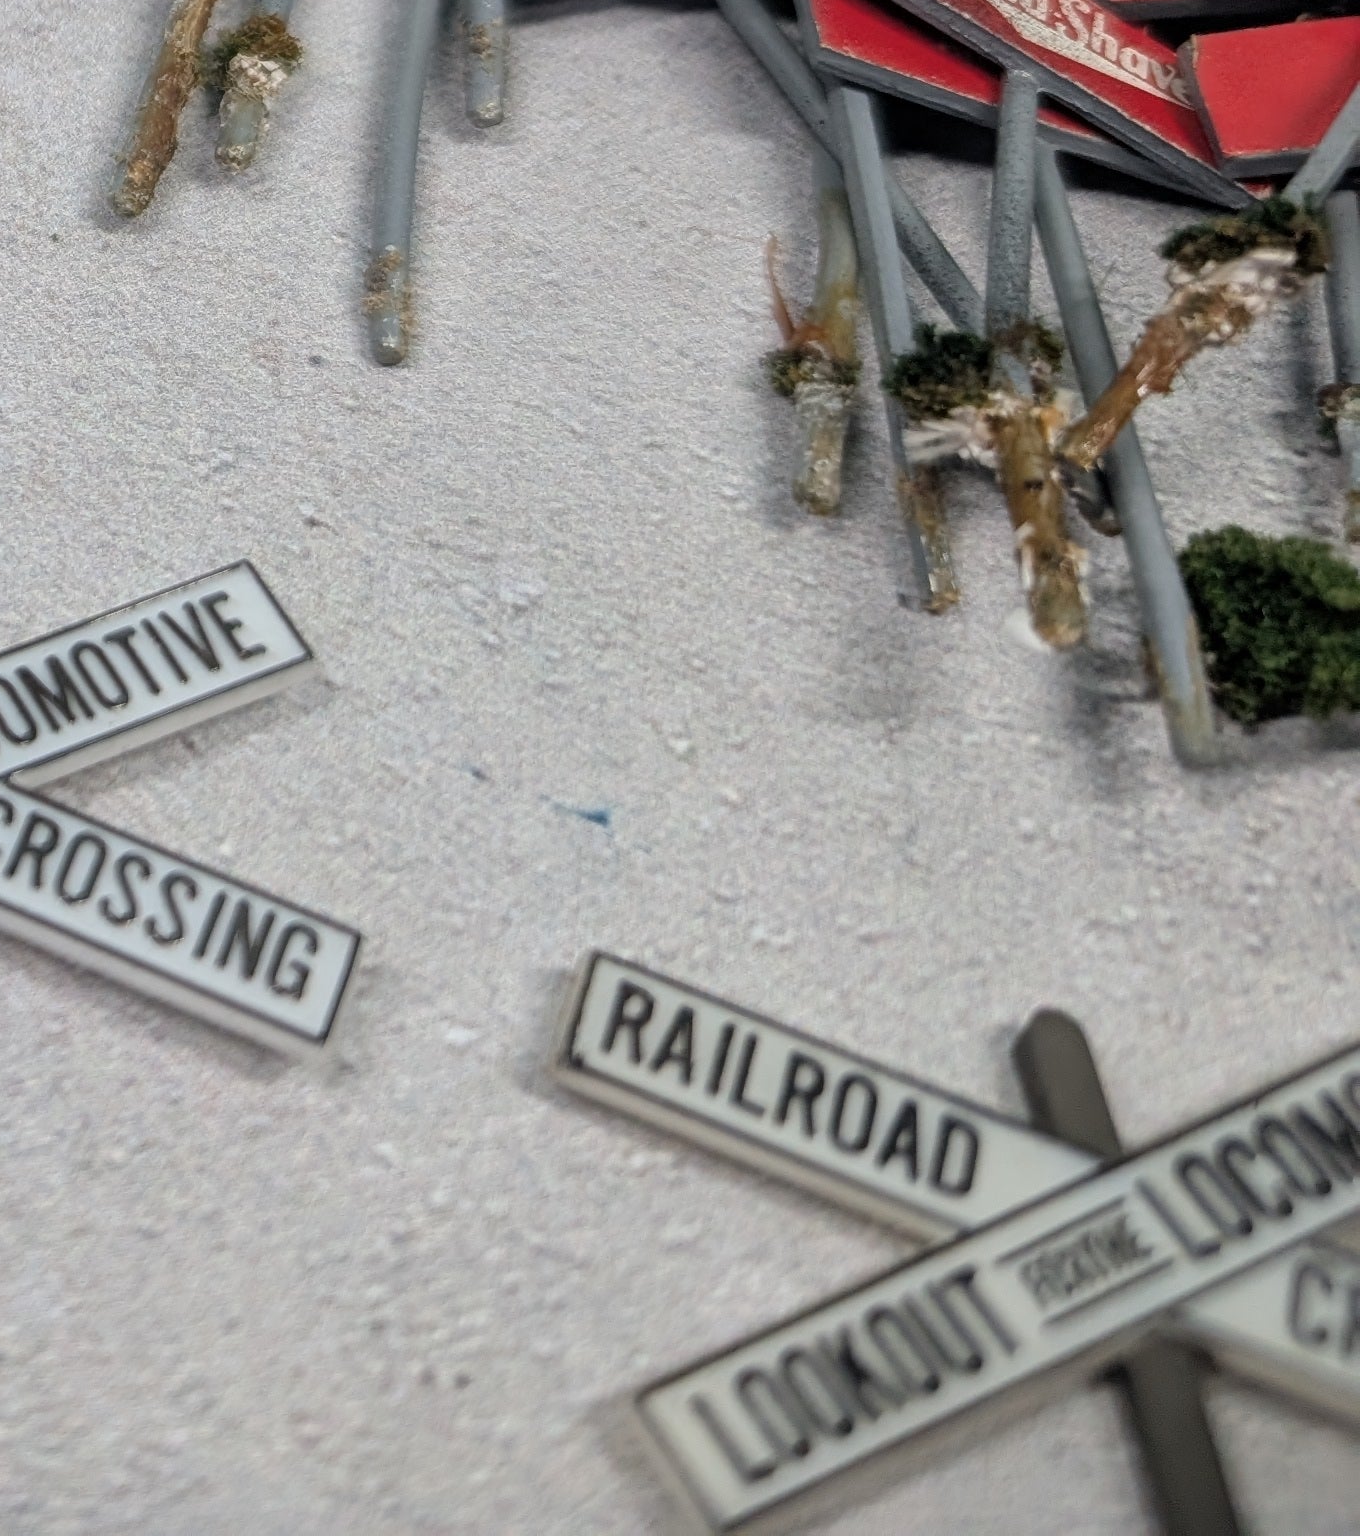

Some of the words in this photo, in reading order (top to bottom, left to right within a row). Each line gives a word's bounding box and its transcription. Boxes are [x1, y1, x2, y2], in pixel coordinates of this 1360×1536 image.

[599, 978, 983, 1199] RAILROAD
[688, 1267, 1022, 1487] LOOKOUT
[1134, 1069, 1360, 1260] LOCOM
